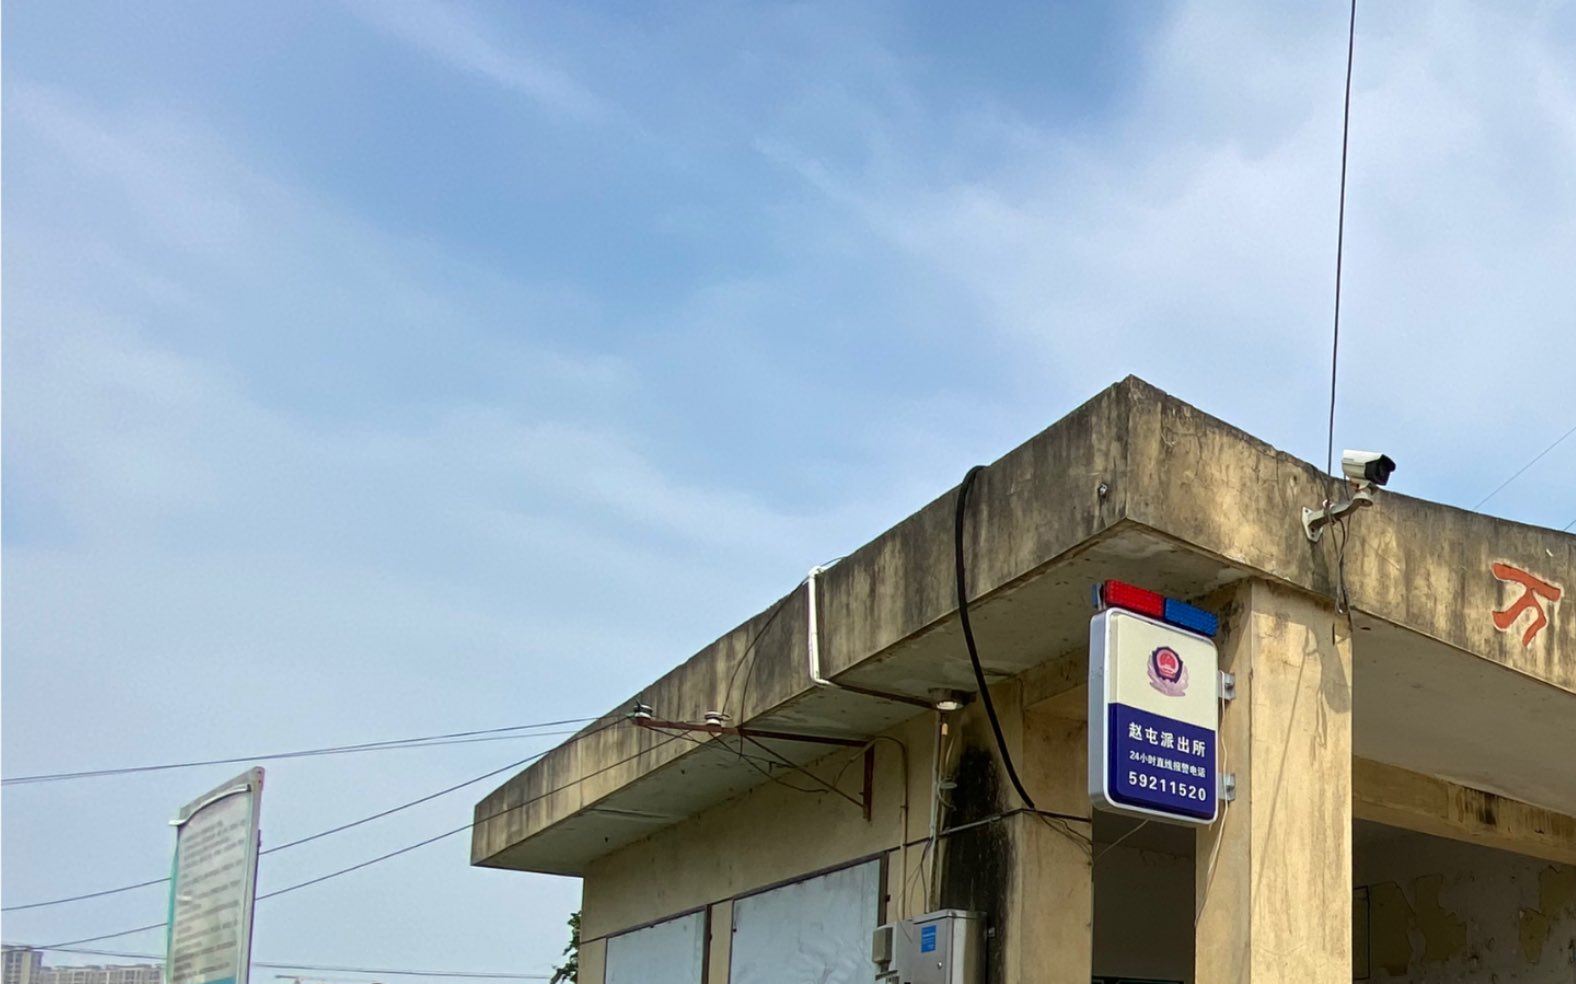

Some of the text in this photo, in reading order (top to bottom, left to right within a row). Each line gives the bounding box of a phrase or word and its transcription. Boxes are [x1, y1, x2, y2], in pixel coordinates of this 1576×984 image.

[1128, 721, 1206, 758] 赵屯派出所
[1128, 750, 1206, 779] 24小时直线报警电话
[1128, 771, 1207, 801] 59211520
